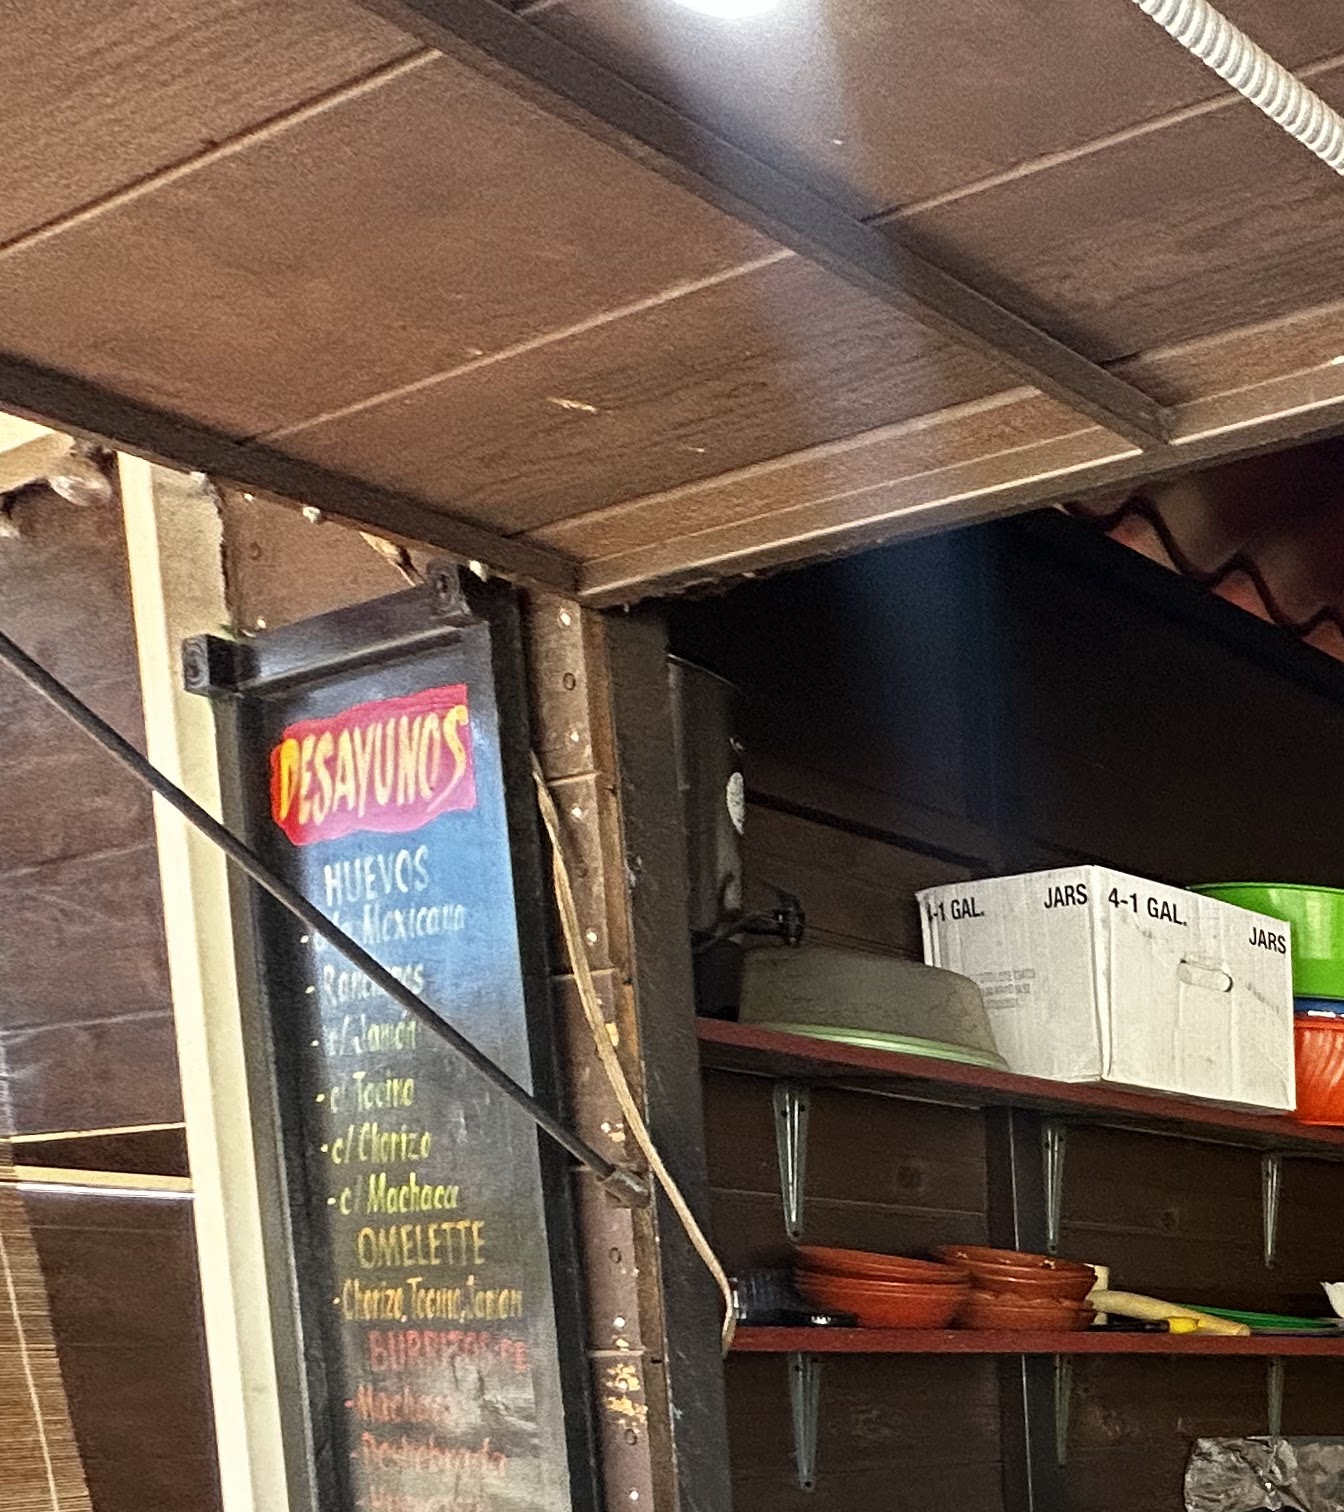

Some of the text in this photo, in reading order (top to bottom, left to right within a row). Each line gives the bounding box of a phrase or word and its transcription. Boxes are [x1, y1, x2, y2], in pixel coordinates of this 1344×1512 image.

[279, 703, 470, 826] DESAYUNOS
[324, 844, 430, 907] HUEVOS
[1044, 882, 1088, 909] JARS
[951, 896, 986, 920] GAL.
[1108, 885, 1189, 927] 4-1 GAL.
[1248, 926, 1287, 955] JARS
[358, 1121, 432, 1163] Chorizo
[367, 1171, 460, 1214] Machaca
[357, 1219, 486, 1270] OMELETTE
